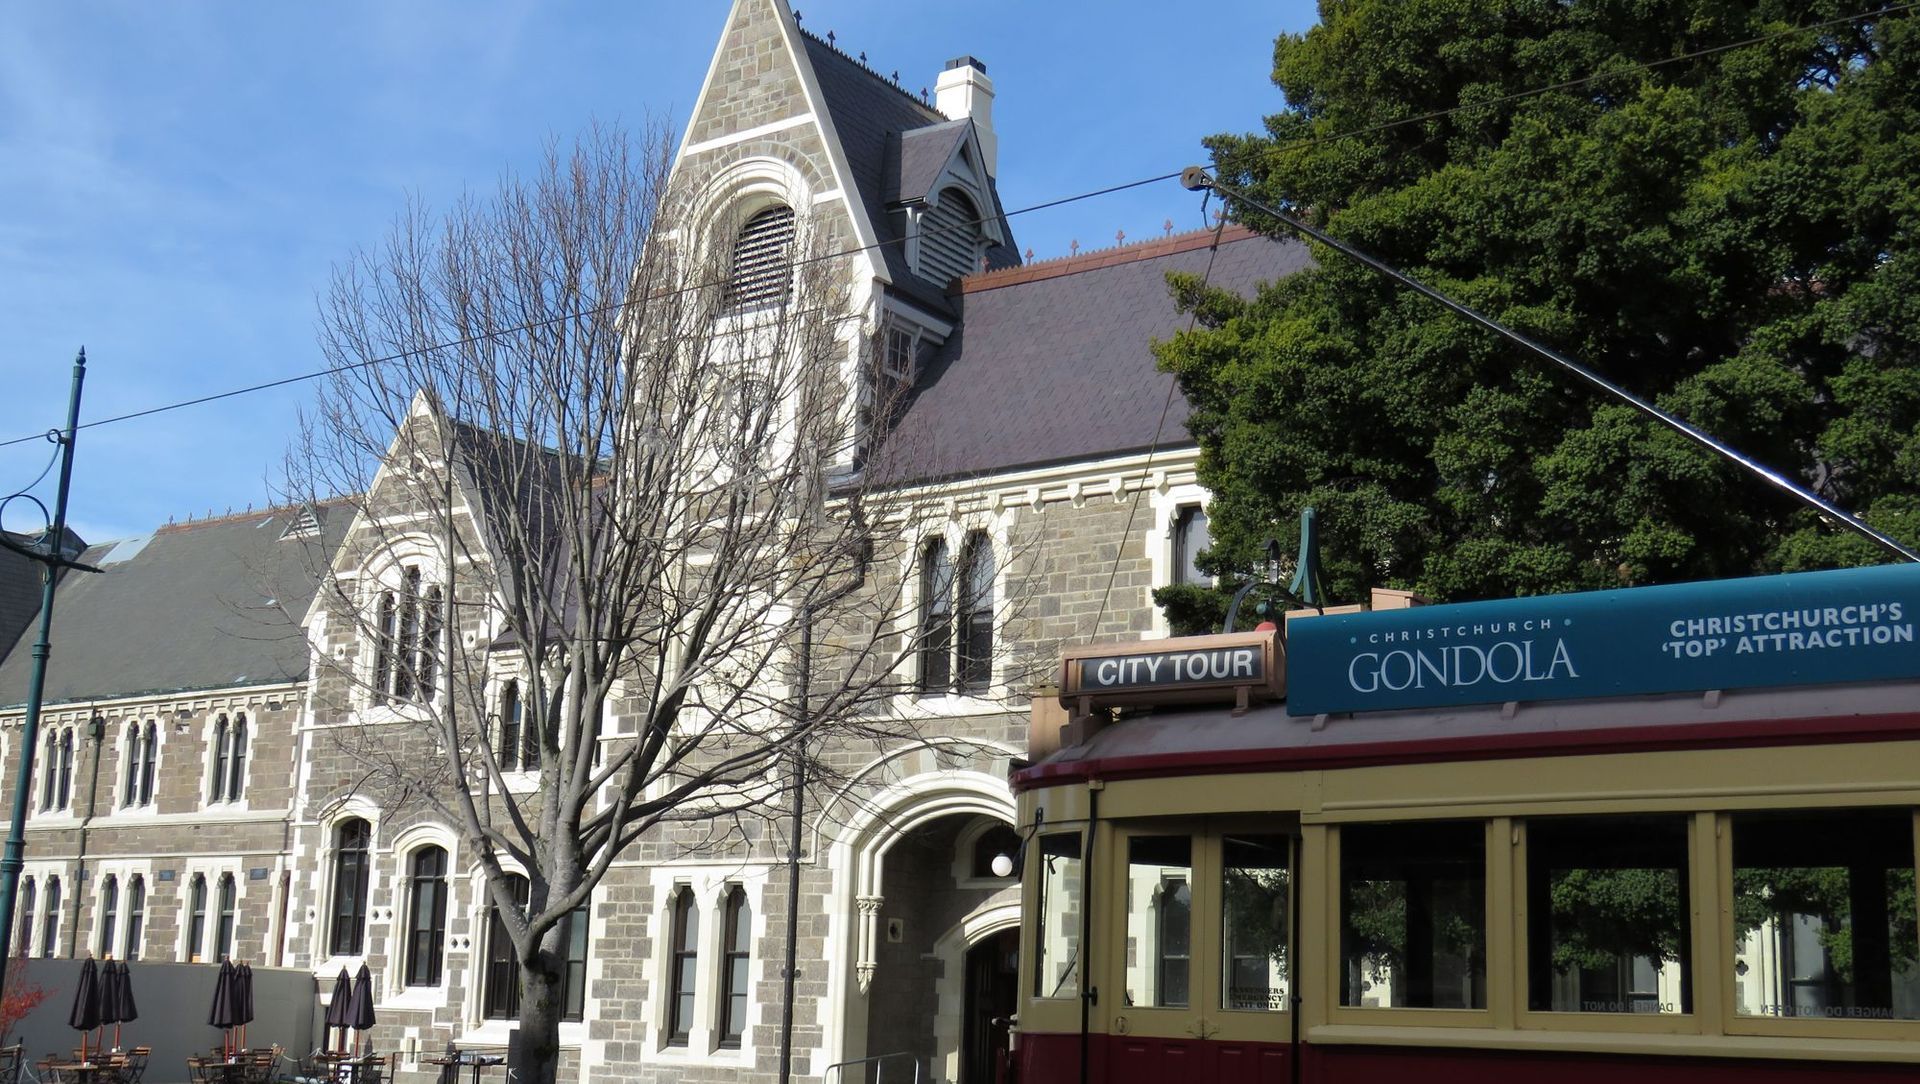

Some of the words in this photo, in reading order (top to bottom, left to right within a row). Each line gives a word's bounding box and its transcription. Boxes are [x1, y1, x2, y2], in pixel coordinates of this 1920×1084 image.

[1368, 618, 1551, 644] CHRISTCHURCH
[1735, 624, 1912, 654] ATTRACTION
[1097, 656, 1164, 686] CITY
[1171, 649, 1254, 680] TOUR
[1348, 637, 1580, 693] GONDOLA
